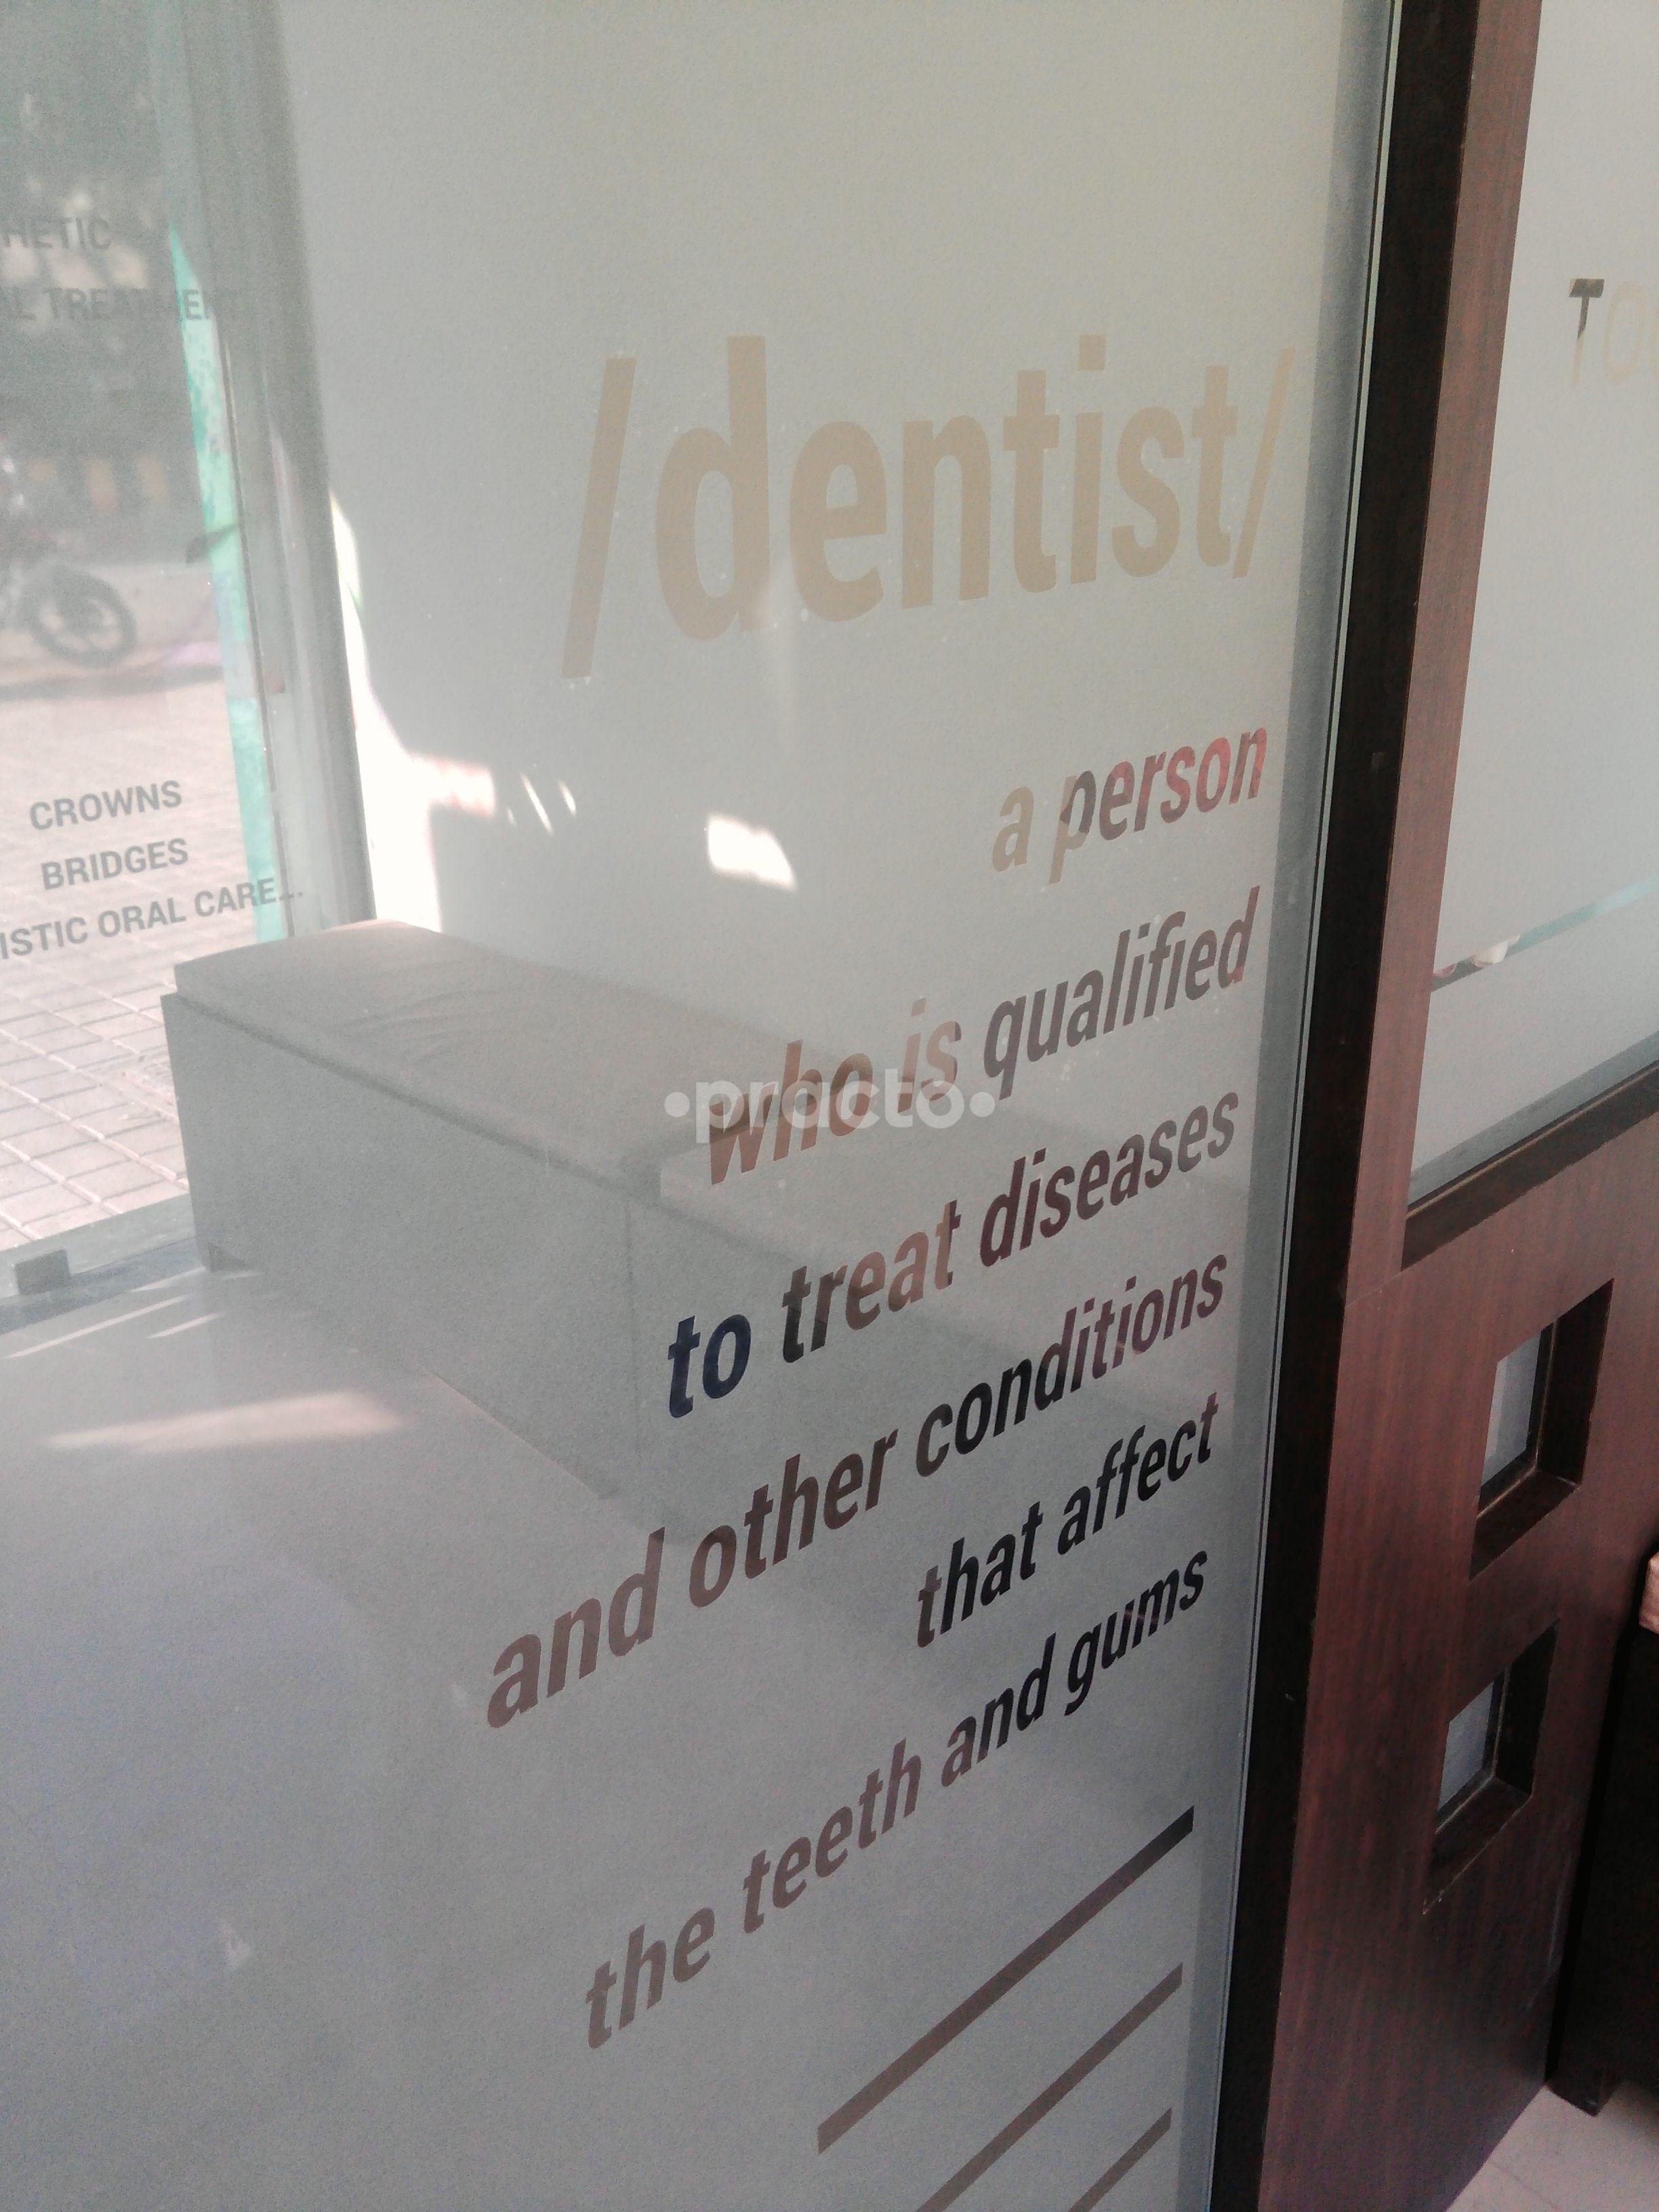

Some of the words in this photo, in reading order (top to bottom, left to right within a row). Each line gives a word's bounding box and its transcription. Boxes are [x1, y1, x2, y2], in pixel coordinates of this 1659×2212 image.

[1568, 278, 1659, 388] TO
[562, 333, 1296, 678] /dentist/
[0, 917, 88, 960] ISTIC
[98, 898, 186, 937] ORAL
[30, 781, 182, 830] CROWNS
[41, 838, 188, 890] BRIDGES
[991, 786, 1035, 872] a
[1048, 722, 1267, 884] person
[710, 1039, 872, 1185] who
[898, 998, 961, 1112] is
[983, 886, 1261, 1099] qualified
[668, 1313, 751, 1418] to
[781, 1199, 961, 1363] treat
[980, 1092, 1239, 1267] diseases
[487, 1527, 665, 1728] and
[689, 1429, 897, 1607] other
[916, 1254, 1227, 1477] conditions
[916, 1501, 1044, 1647] that
[1057, 1391, 1218, 1555] affect
[585, 1905, 715, 2049] the
[743, 1738, 921, 1932] teeth
[941, 1632, 1056, 1788] and
[1064, 1551, 1208, 1715] gums
